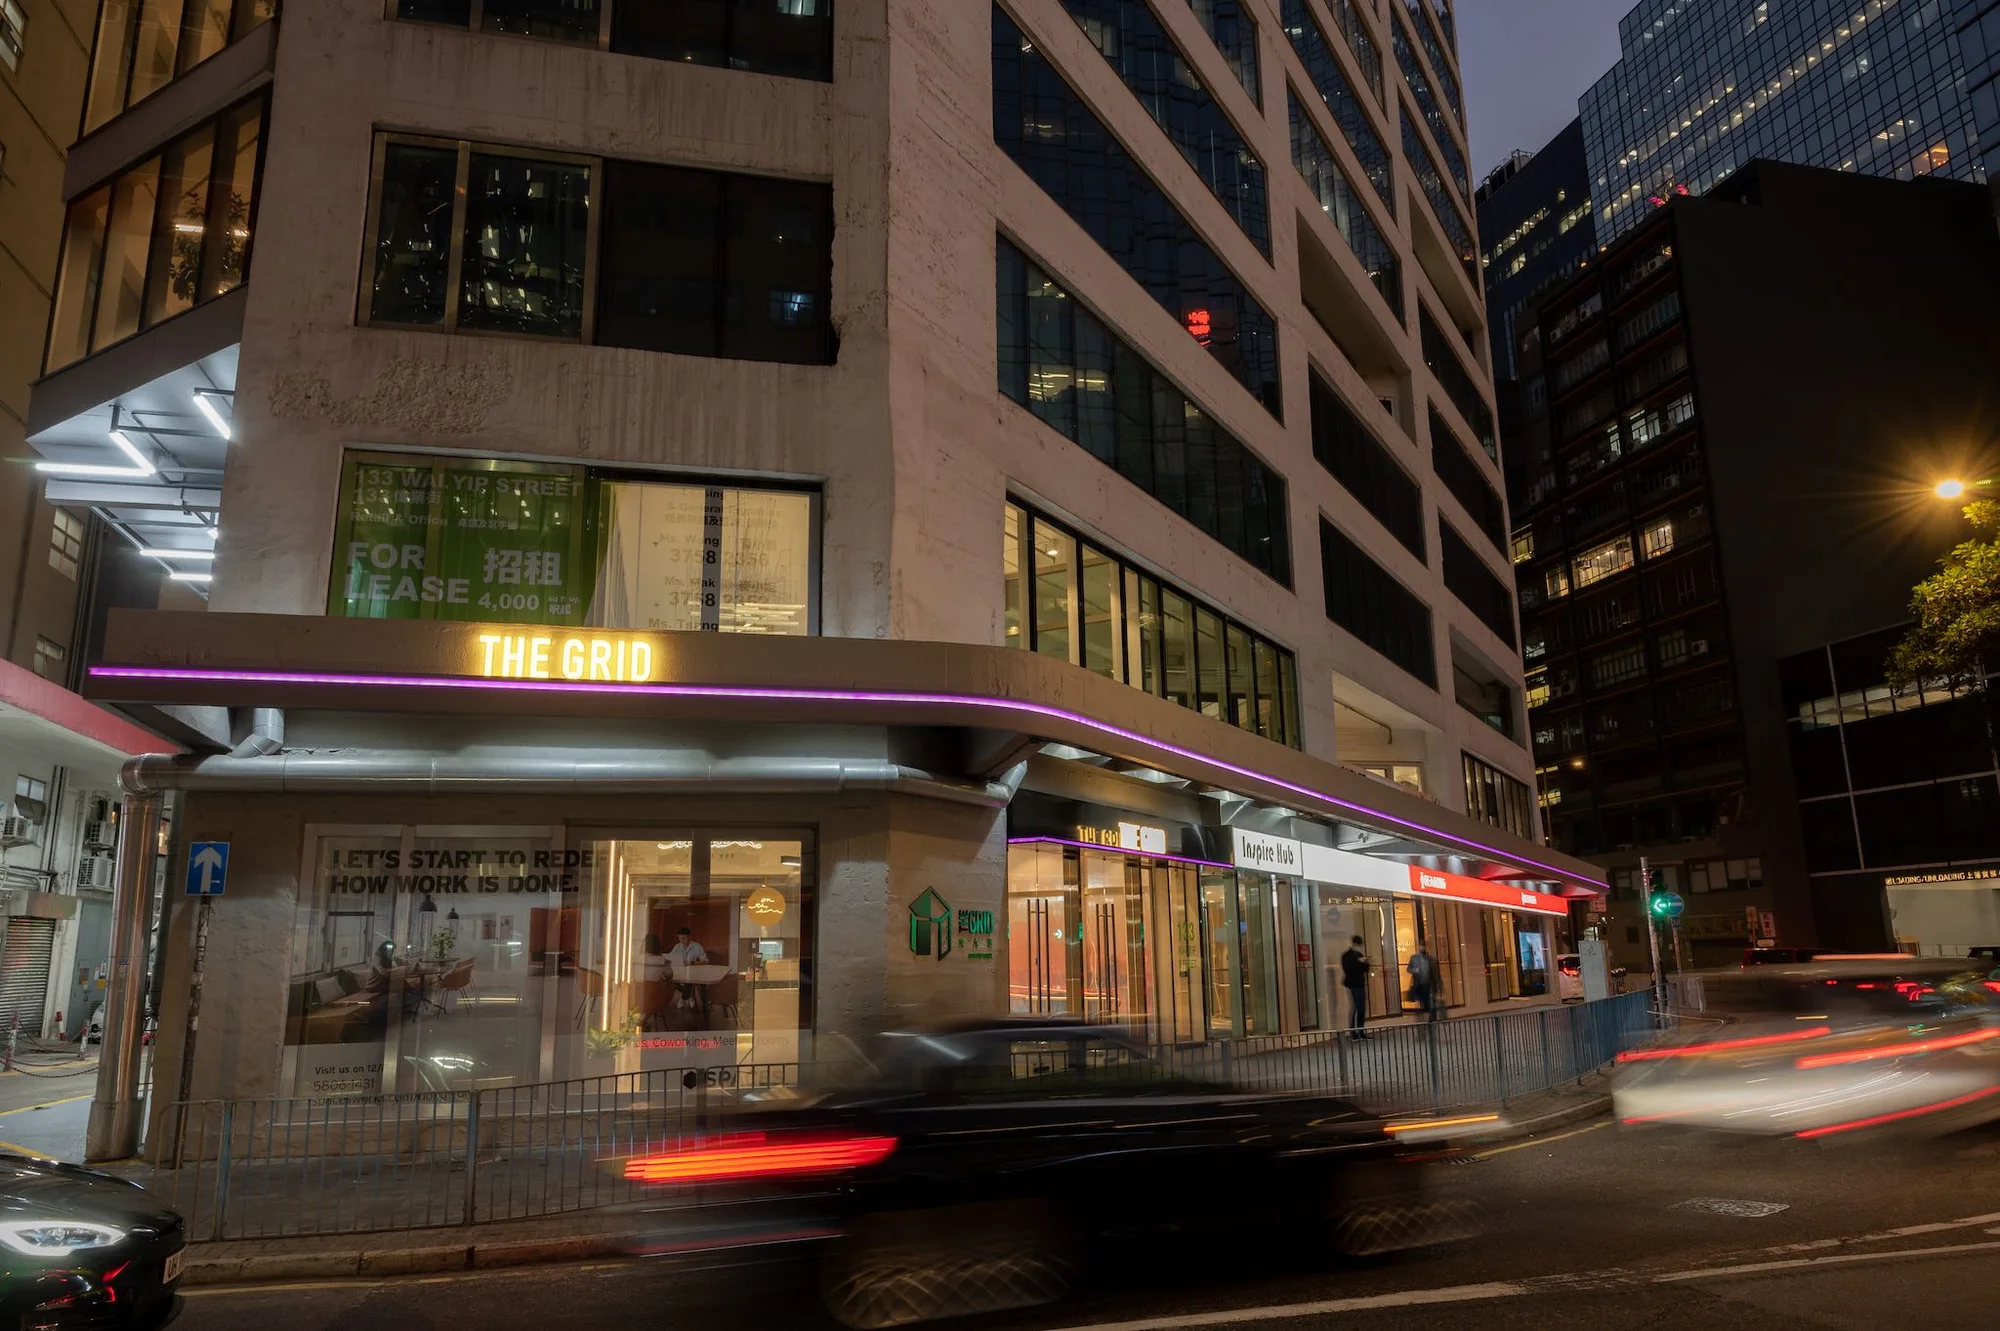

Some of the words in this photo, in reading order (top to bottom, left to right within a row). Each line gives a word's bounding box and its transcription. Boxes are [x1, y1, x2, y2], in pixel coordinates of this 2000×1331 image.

[354, 469, 393, 486] 133
[401, 472, 444, 488] WAI
[453, 475, 489, 491] YIP
[495, 478, 583, 497] STREET
[348, 542, 425, 570] FOR
[483, 547, 562, 586] 招租
[344, 573, 470, 604] LEASE
[478, 592, 540, 612] 4,000
[480, 635, 552, 679] THE
[562, 638, 652, 682] GRID
[332, 849, 400, 869] LET'S
[408, 849, 490, 869] START
[494, 850, 526, 868] TO
[1242, 836, 1274, 865] Inspire
[1276, 843, 1294, 865] Hub
[330, 874, 389, 894] HOW
[396, 874, 469, 894] WORK
[477, 875, 500, 893] IS
[507, 874, 579, 893] DONE.
[968, 910, 994, 935] GRID
[1177, 922, 1195, 942] 133
[652, 1036, 710, 1049] Coworking,
[314, 1064, 335, 1075] Visit
[339, 1066, 350, 1074] us
